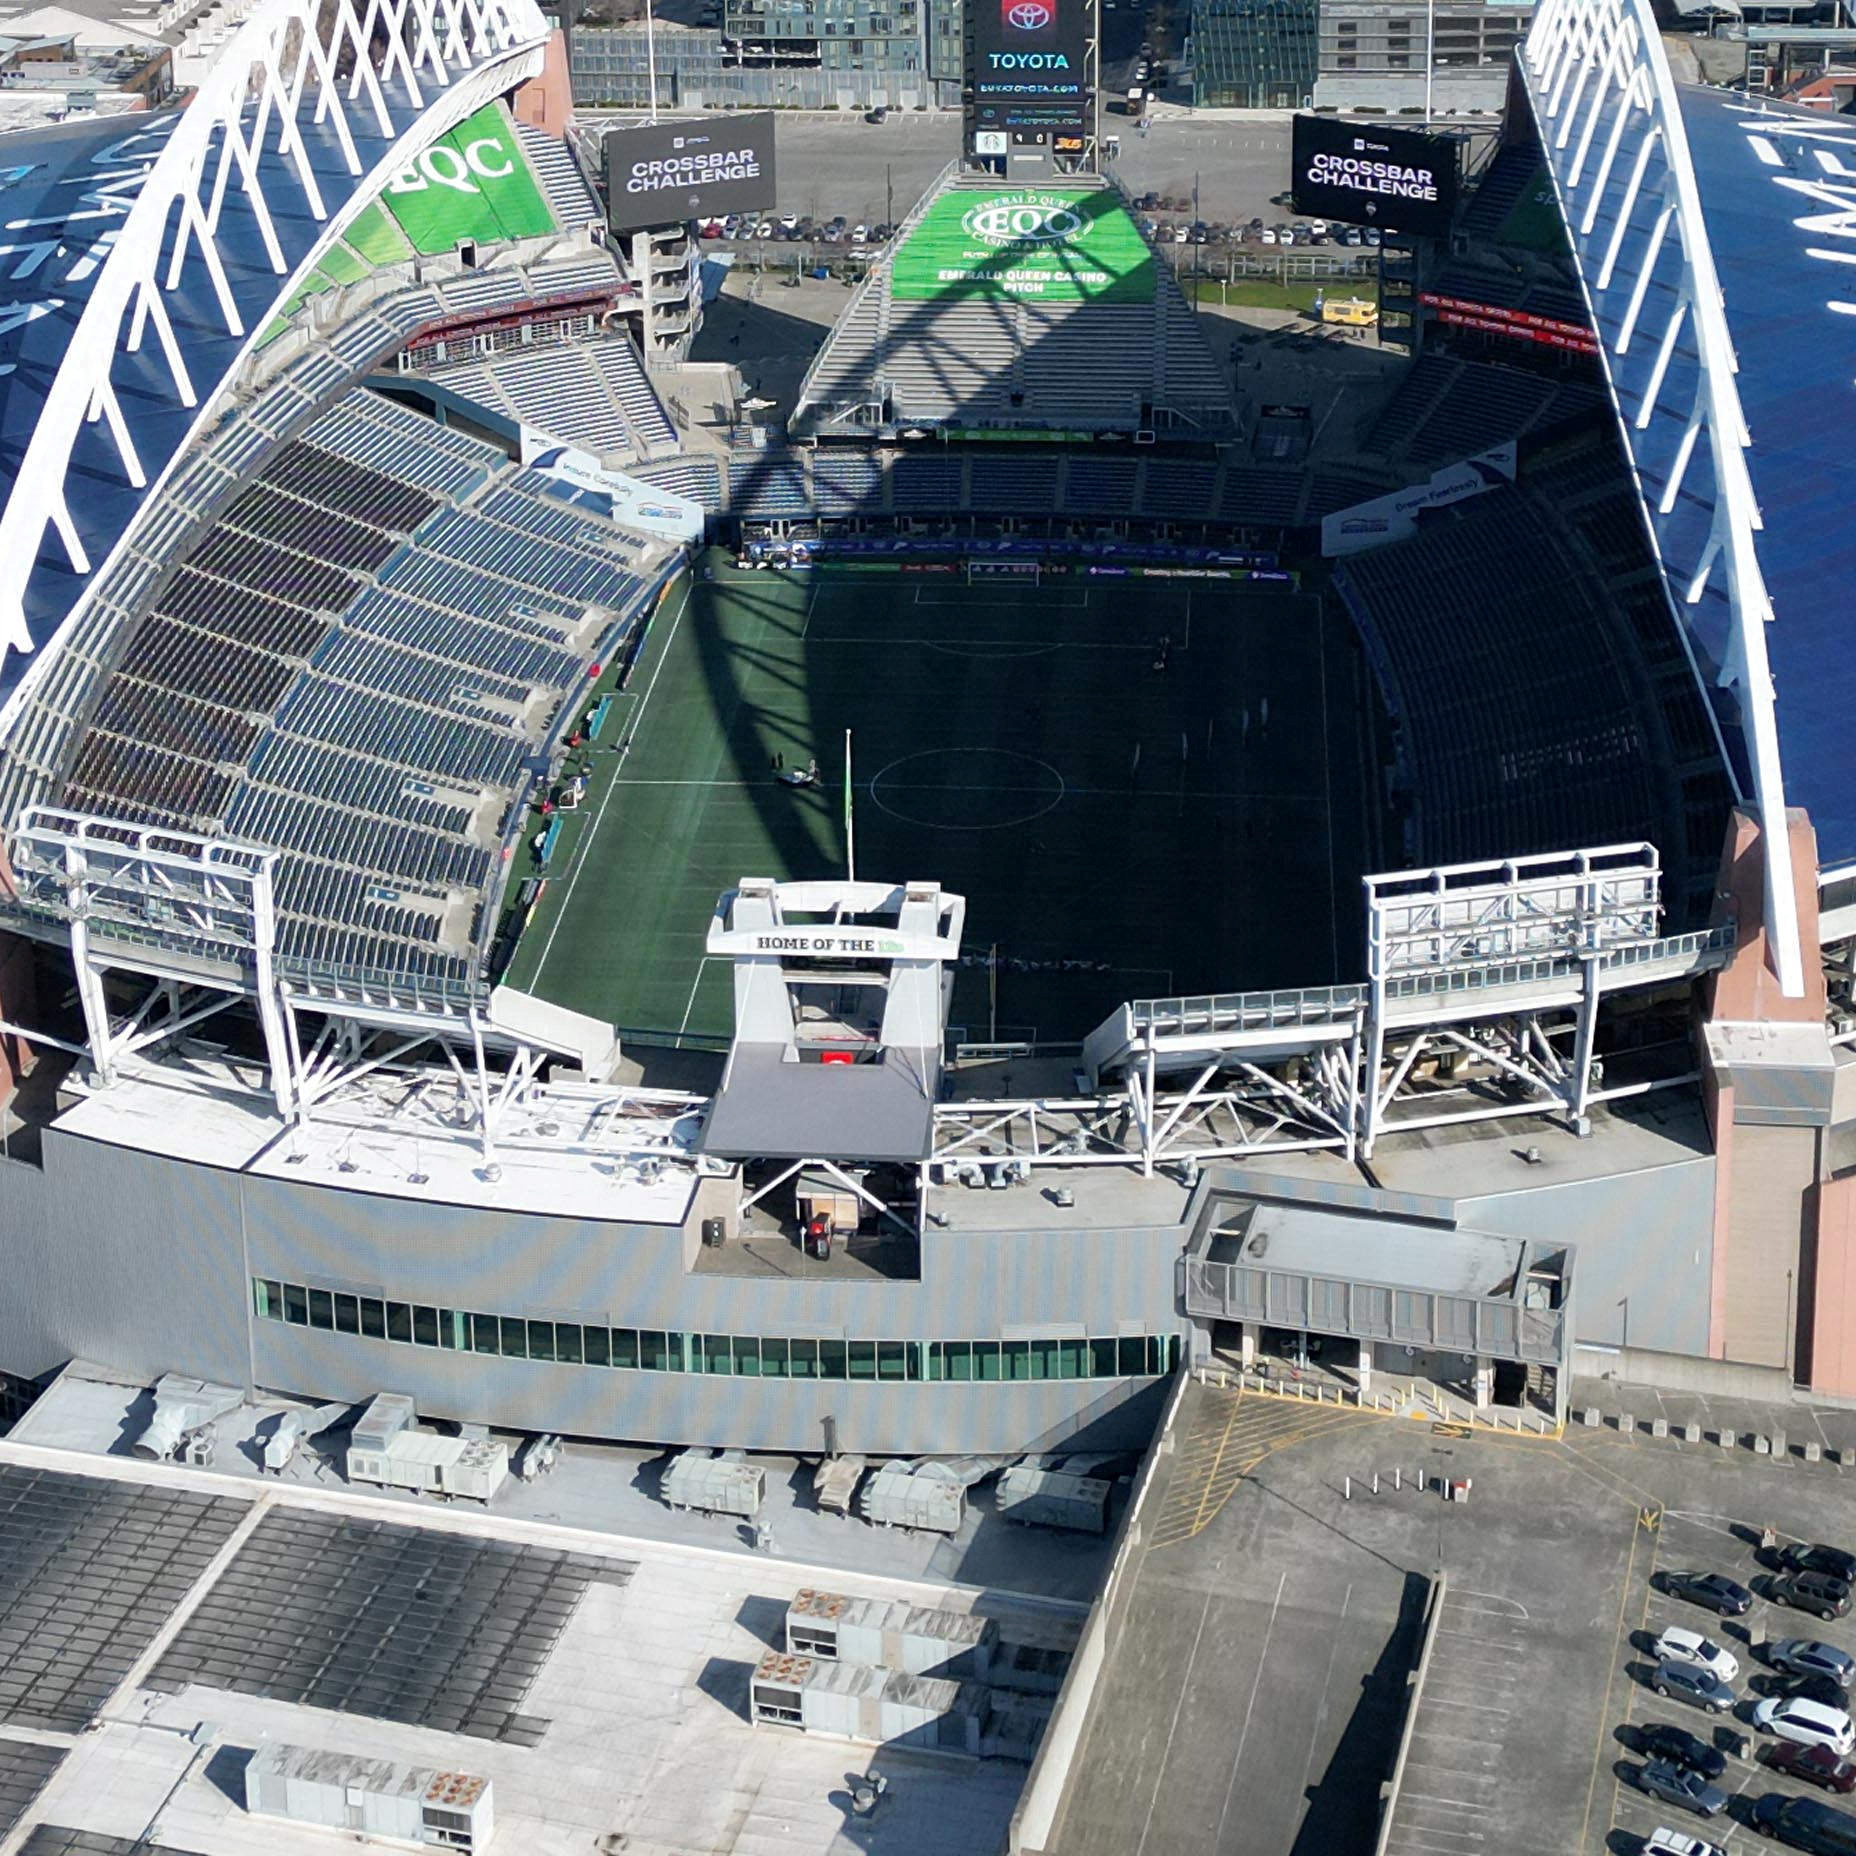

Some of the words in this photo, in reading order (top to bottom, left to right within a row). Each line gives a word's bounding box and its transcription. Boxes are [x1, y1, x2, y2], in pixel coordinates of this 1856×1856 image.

[989, 53, 1070, 69] TOYOTA
[631, 149, 755, 178] CROSSBAR
[1312, 153, 1433, 185] CROSSBAR
[626, 162, 761, 193] CHALLENGE
[1307, 168, 1439, 202] CHALLENGE
[989, 209, 1074, 235] EQC
[938, 270, 1002, 281] EMERALD
[1006, 270, 1051, 282] QUEEN
[1054, 270, 1107, 282] CASINO
[1003, 282, 1044, 292] PITCH
[757, 937, 809, 950] HOME
[813, 937, 835, 950] OF
[839, 938, 874, 951] THE
